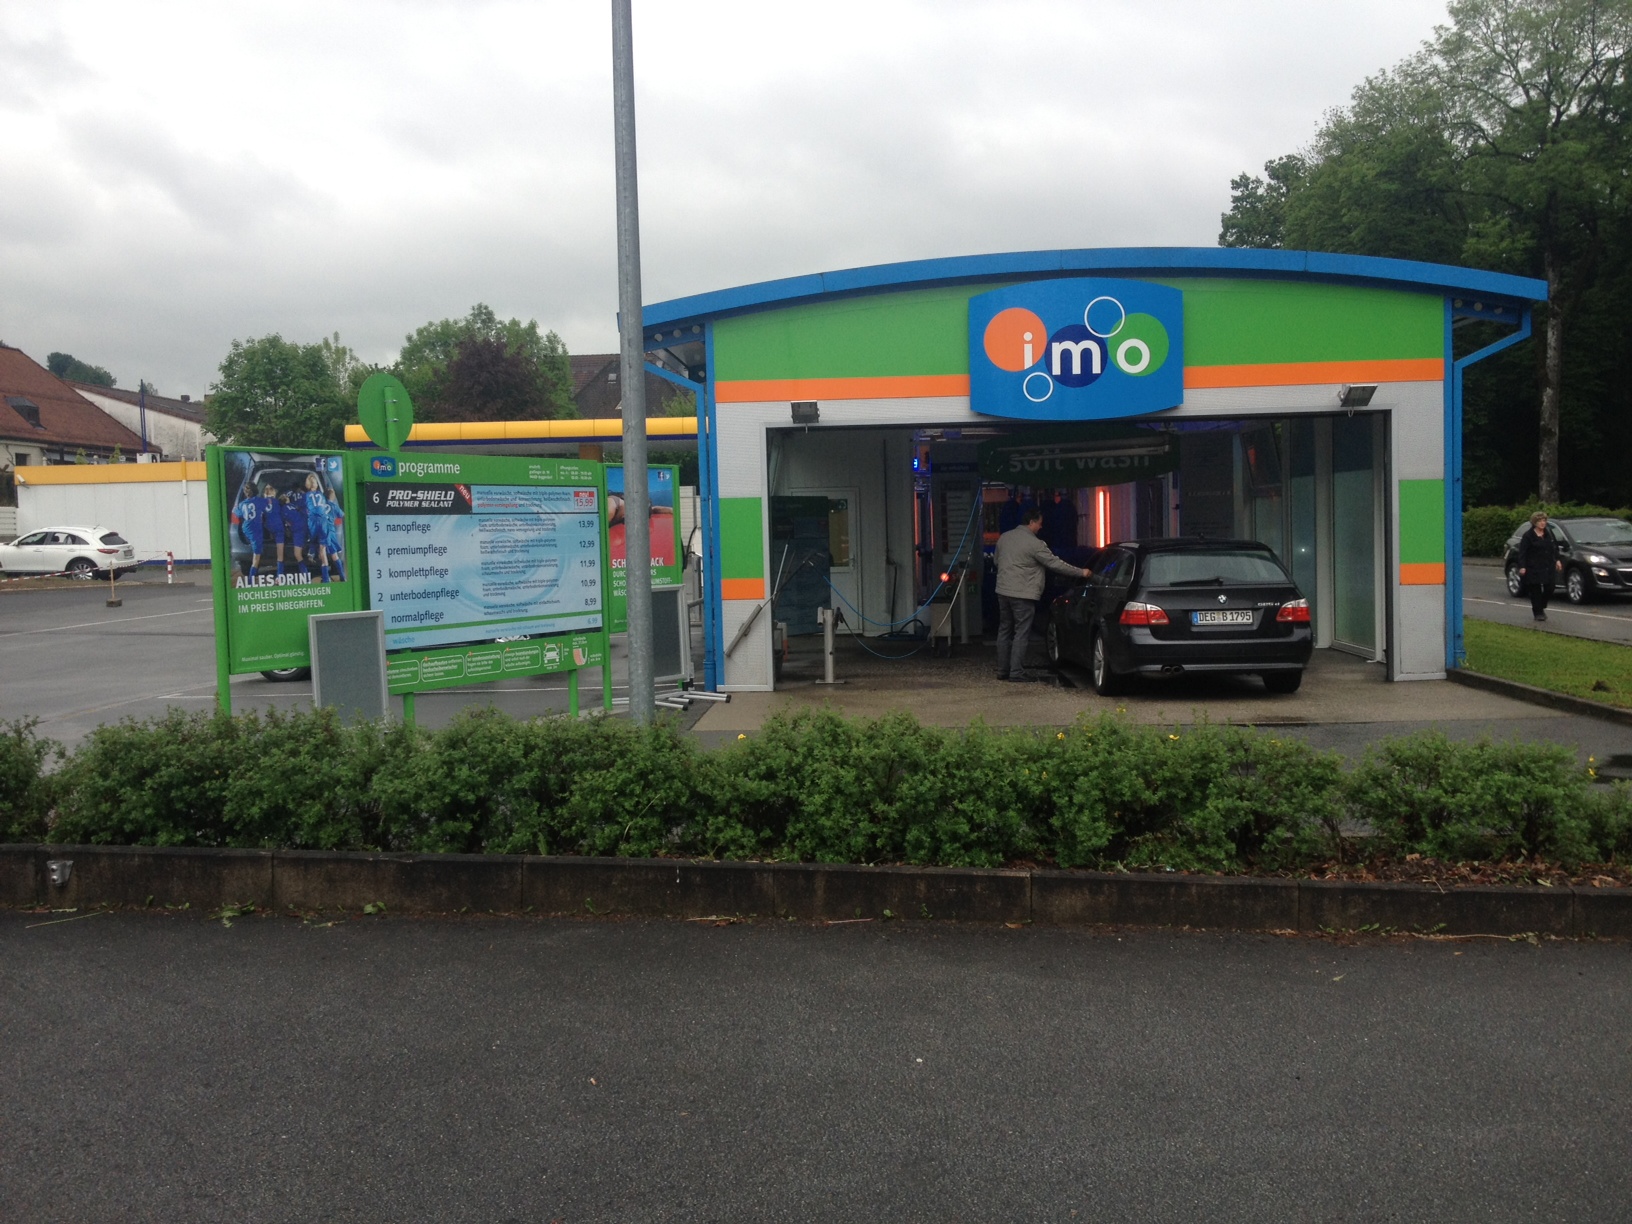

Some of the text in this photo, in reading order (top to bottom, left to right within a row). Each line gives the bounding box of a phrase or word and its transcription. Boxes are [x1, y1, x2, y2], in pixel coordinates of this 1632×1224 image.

[1023, 331, 1151, 376] imo
[398, 461, 461, 477] programme
[372, 491, 380, 504] 6
[387, 490, 455, 500] PRO-SHIELD
[459, 485, 471, 500] neu
[308, 493, 324, 507] 12
[575, 498, 594, 507] 15,99
[241, 503, 257, 520] 13
[374, 522, 431, 534] 5 nanopflege
[578, 520, 594, 529] 13,99
[579, 540, 595, 549] 12,99
[375, 544, 448, 558] 4 premiumpflege
[580, 559, 596, 569] 11,99
[612, 557, 664, 569] SCH ACK
[376, 566, 449, 580] 3 komplettpflege
[612, 570, 626, 578] DURC
[235, 572, 312, 589] ALLES DRIN!
[581, 579, 596, 588] 10,99
[613, 580, 627, 588] SCHO
[237, 586, 331, 601] HOCHLEISTUNGSSAUGEN
[377, 587, 460, 602] 2 unterbodenpflege
[613, 588, 627, 597] WÄSC
[238, 599, 325, 614] IM PREIS INBEGRIFFEN.
[584, 598, 597, 606] 8,99
[391, 610, 445, 624] normalpflege
[1198, 611, 1251, 622] DEG B 1795
[392, 636, 415, 645] wäsche
